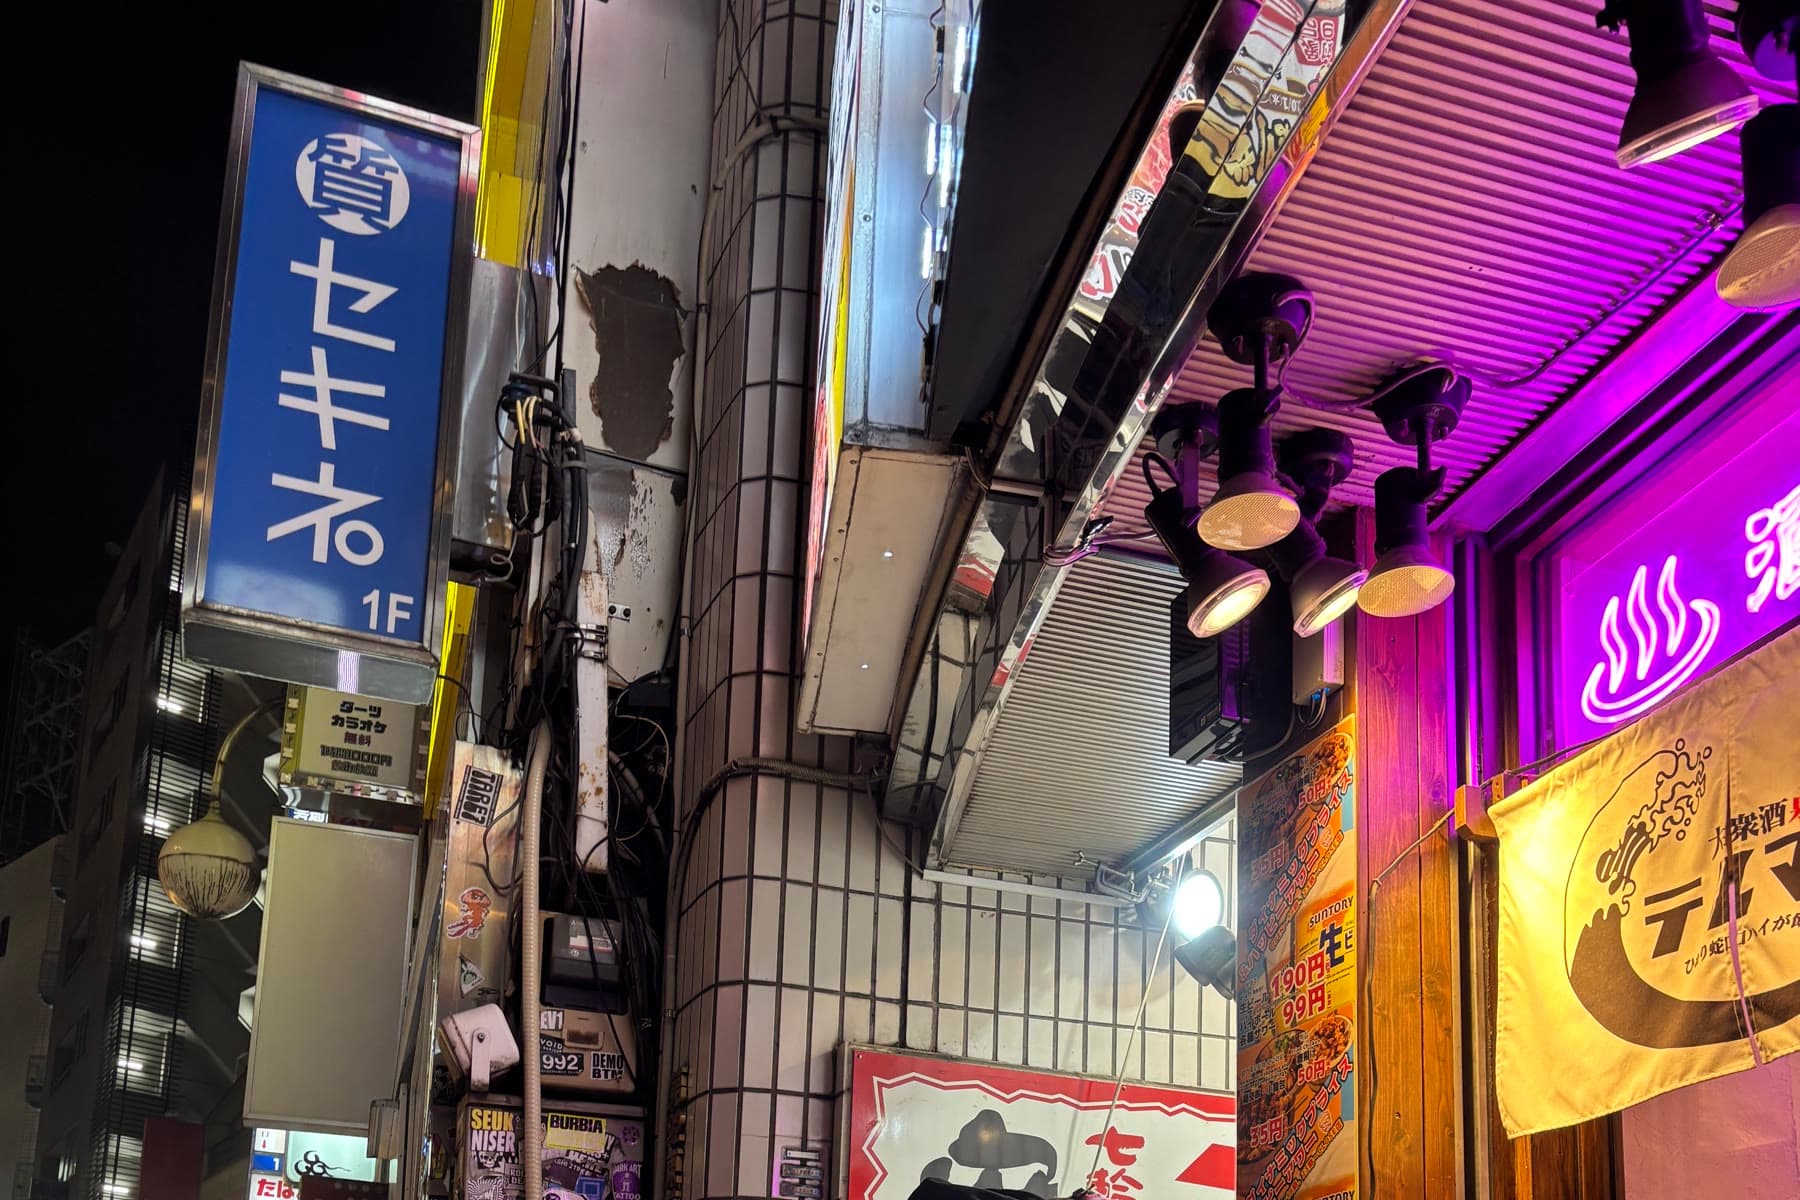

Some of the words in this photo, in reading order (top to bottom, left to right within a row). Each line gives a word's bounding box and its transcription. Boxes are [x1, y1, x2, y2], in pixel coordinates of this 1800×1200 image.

[362, 588, 414, 633] 1F
[340, 701, 382, 718] ダーツ
[331, 715, 387, 733] カラオケ
[1309, 896, 1354, 928] SUNTORY
[1270, 948, 1327, 1000] 190円
[1282, 982, 1327, 1026] 99円
[542, 1054, 579, 1070] 992
[592, 1053, 624, 1069] DEMO
[550, 1114, 603, 1133] BURBIA
